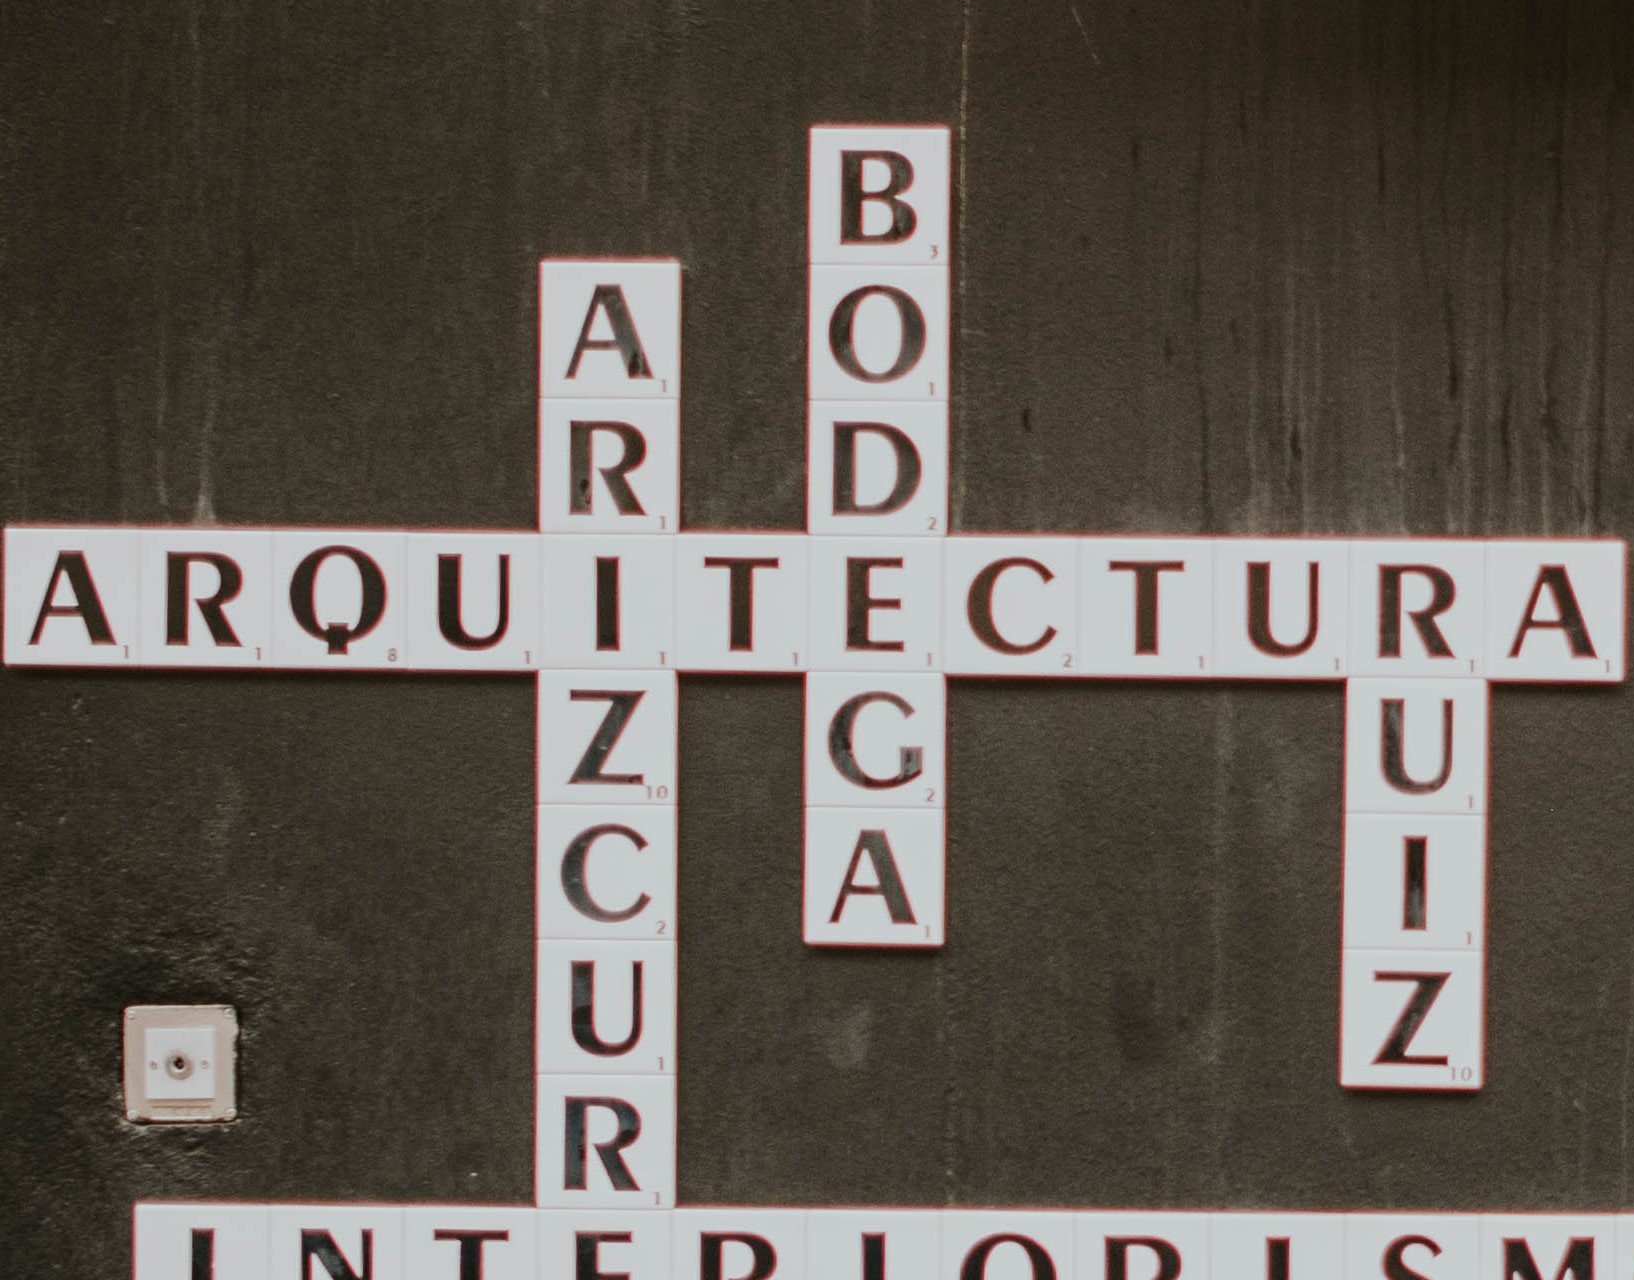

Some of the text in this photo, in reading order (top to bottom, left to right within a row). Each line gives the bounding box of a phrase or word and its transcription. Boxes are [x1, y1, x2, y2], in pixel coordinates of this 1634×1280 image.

[28, 545, 1597, 658] ARQUITECTURA
[828, 150, 926, 925] BODEGA
[1374, 564, 1456, 1066] RUIZ
